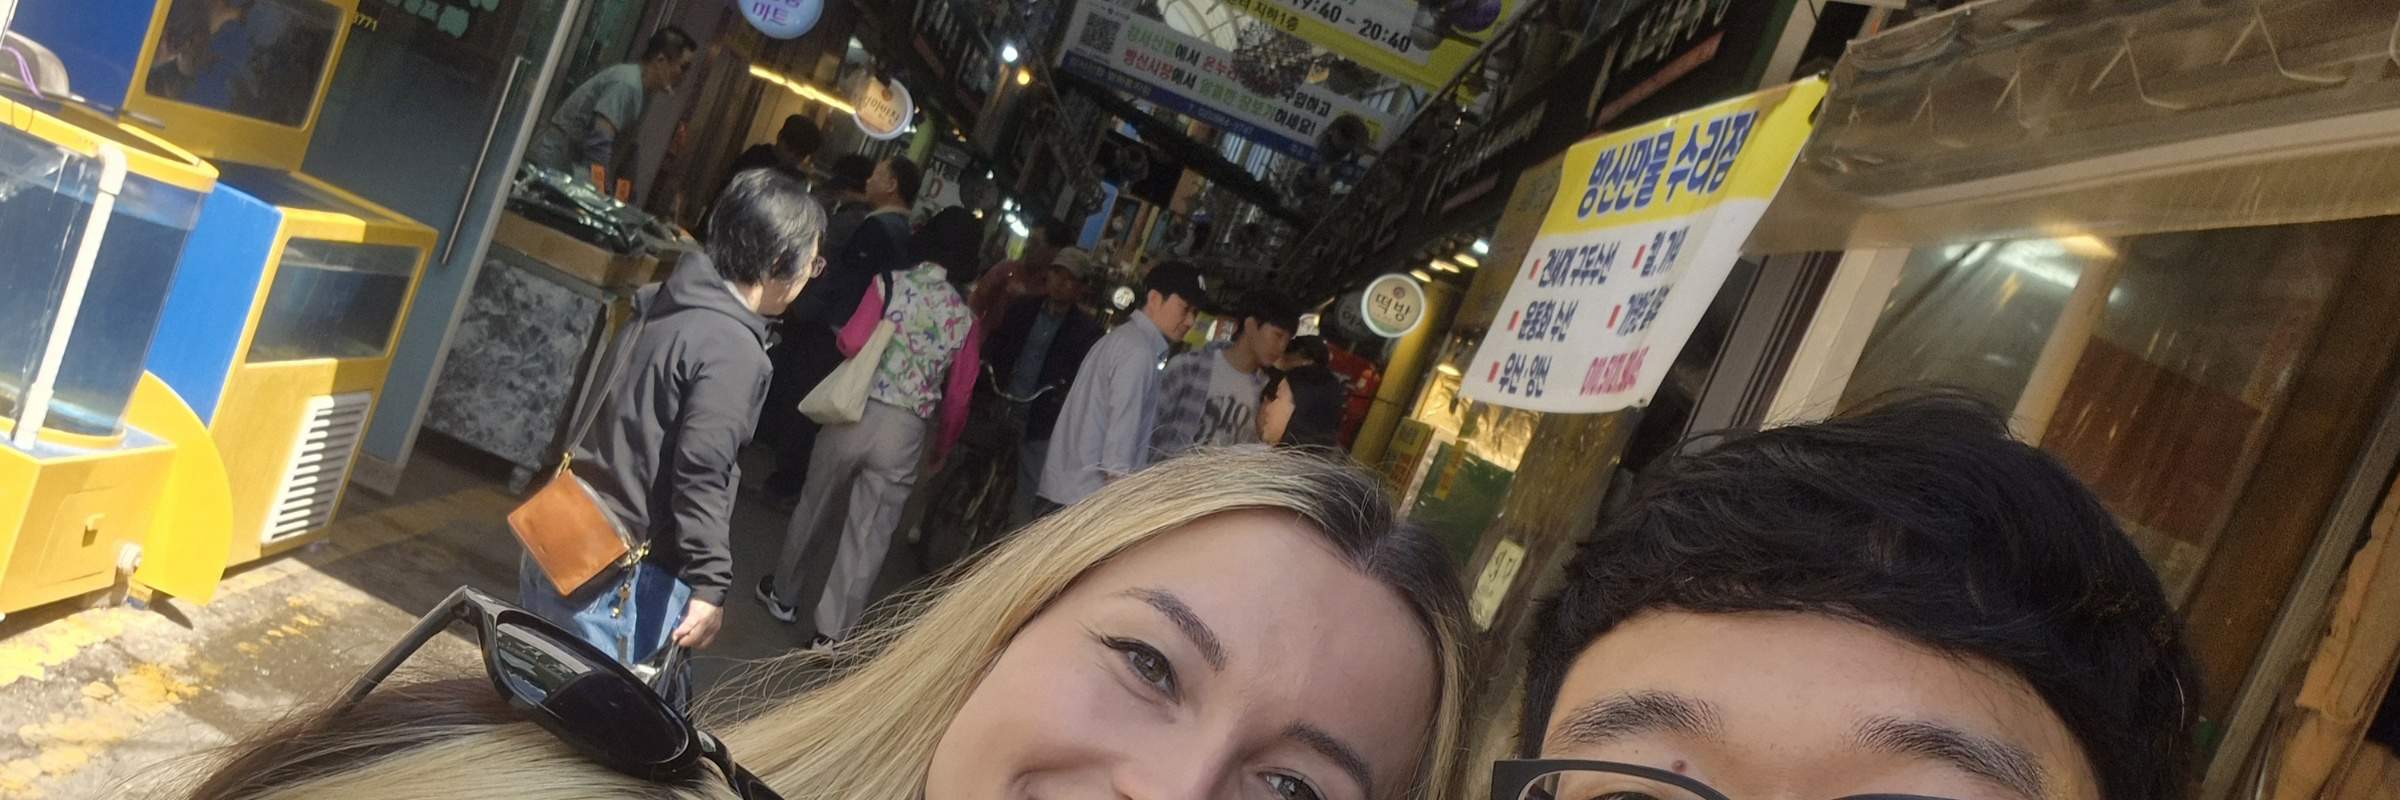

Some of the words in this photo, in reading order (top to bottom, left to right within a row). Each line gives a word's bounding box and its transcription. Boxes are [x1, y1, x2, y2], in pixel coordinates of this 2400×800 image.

[752, 2, 787, 26] 마트
[1358, 19, 1411, 53] 20:40
[1577, 130, 1675, 219] 방신만물
[1666, 110, 1760, 203] 수리점
[1375, 293, 1411, 323] 떡방
[1517, 300, 1556, 341] 운동화
[1550, 300, 1579, 343] 수선
